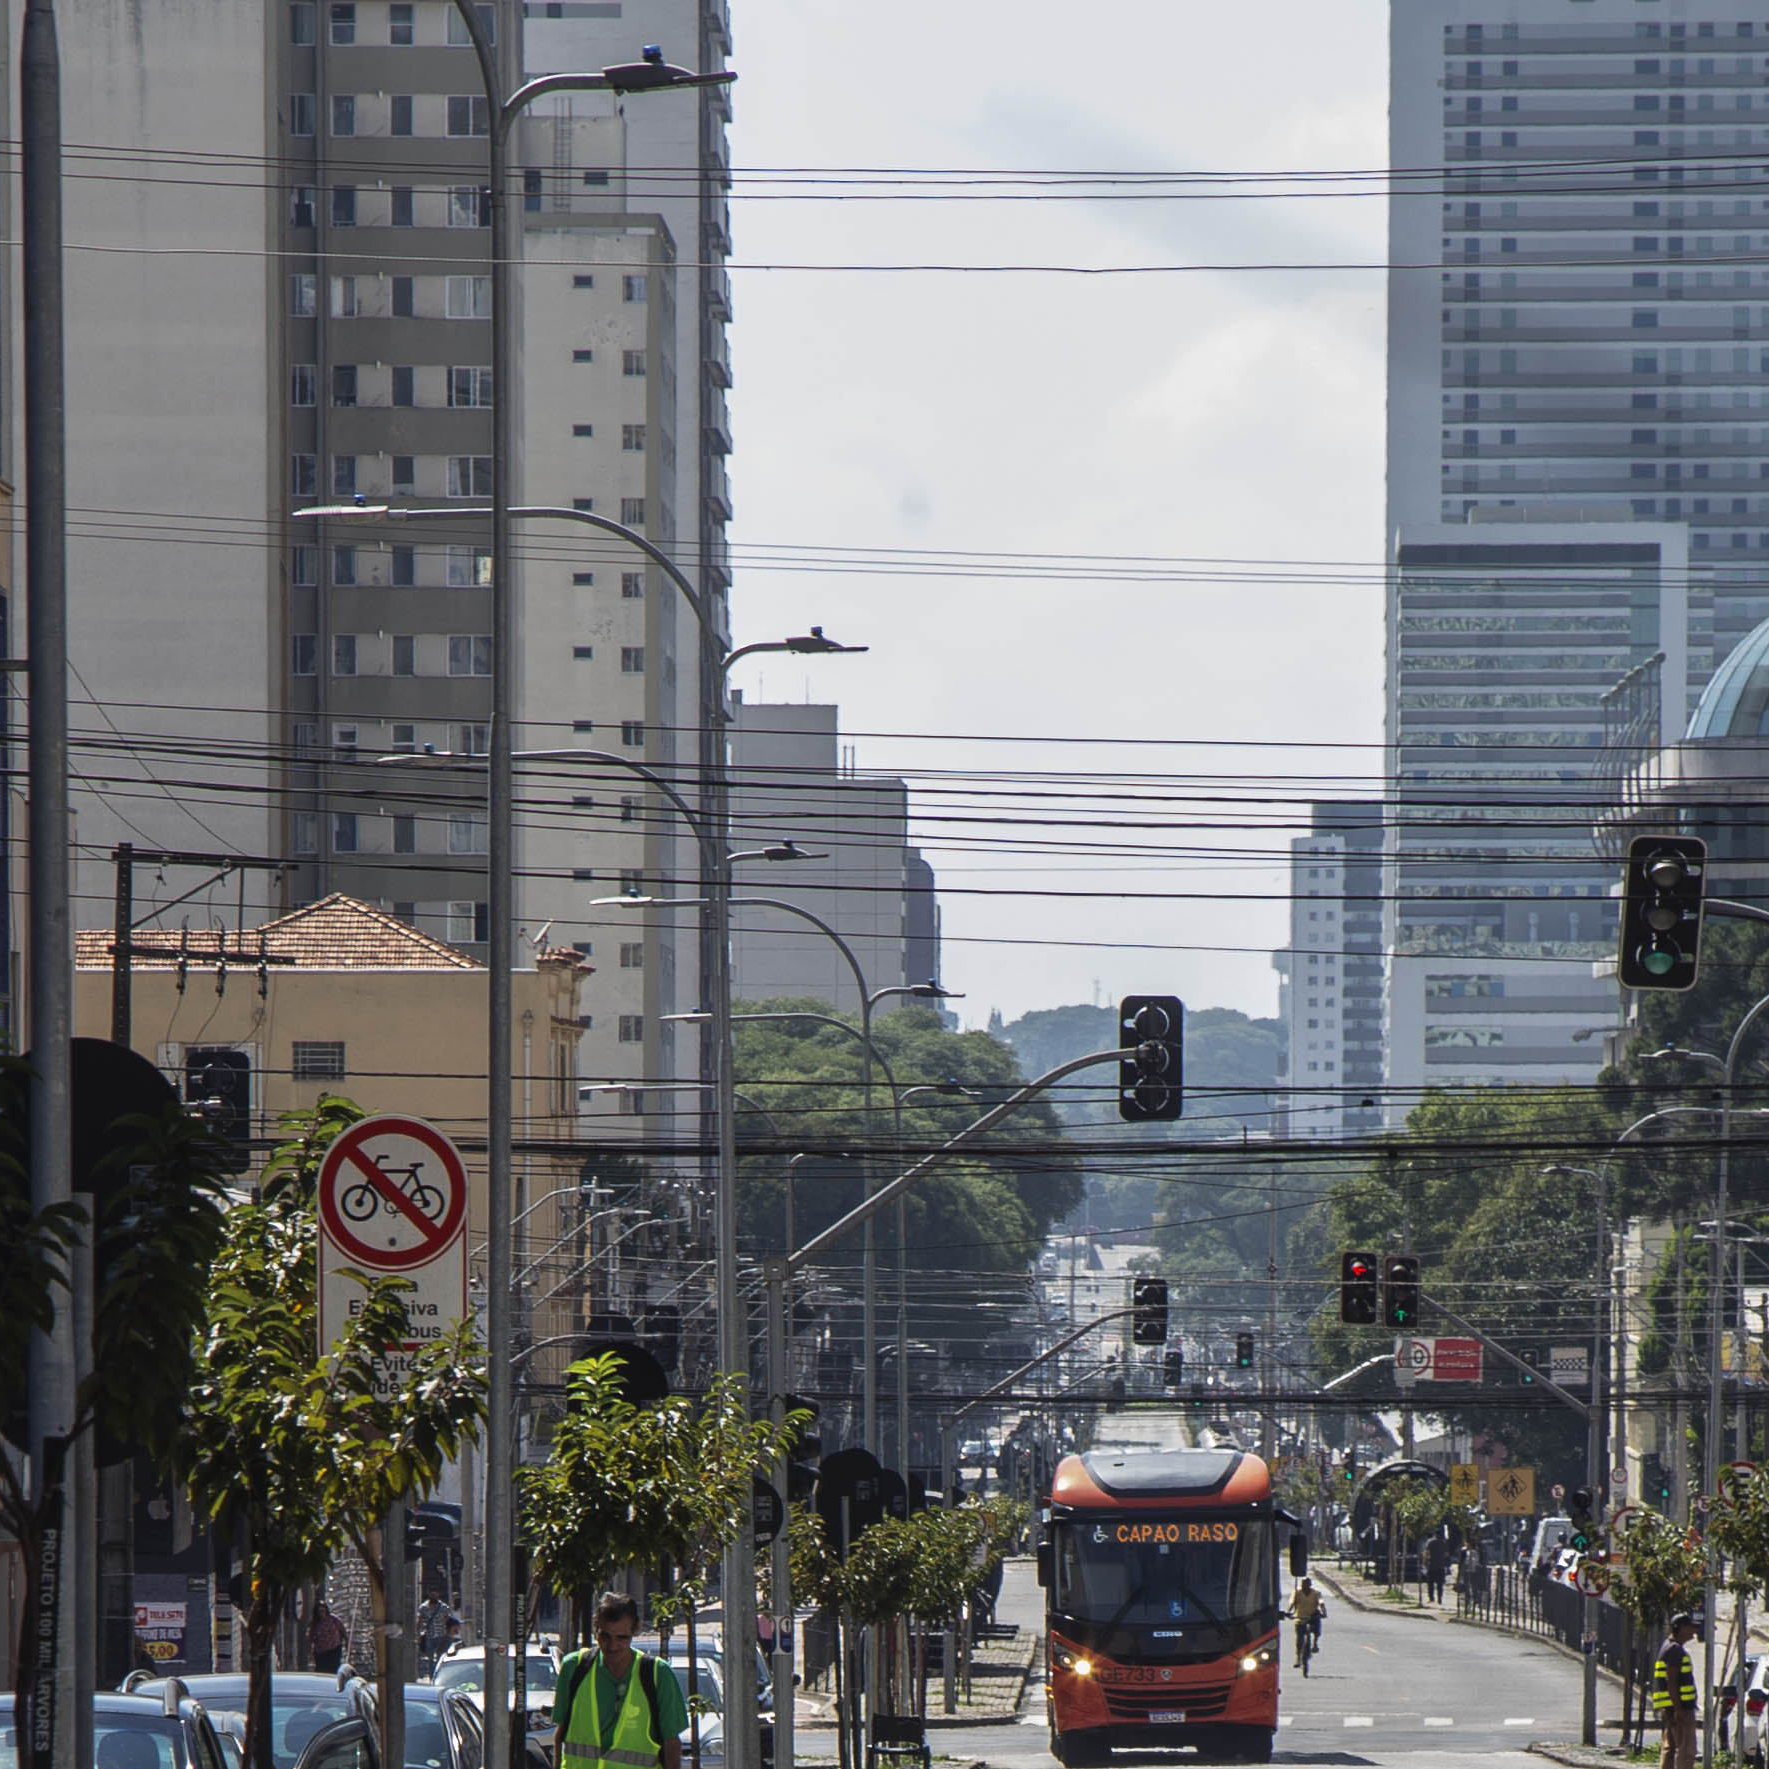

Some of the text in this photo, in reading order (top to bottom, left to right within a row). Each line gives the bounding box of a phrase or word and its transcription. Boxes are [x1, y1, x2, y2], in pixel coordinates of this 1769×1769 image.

[1187, 1522, 1239, 1542] RASO
[39, 1528, 58, 1606] PROJETO
[38, 1611, 54, 1636] 100
[1101, 1666, 1156, 1682] GE733
